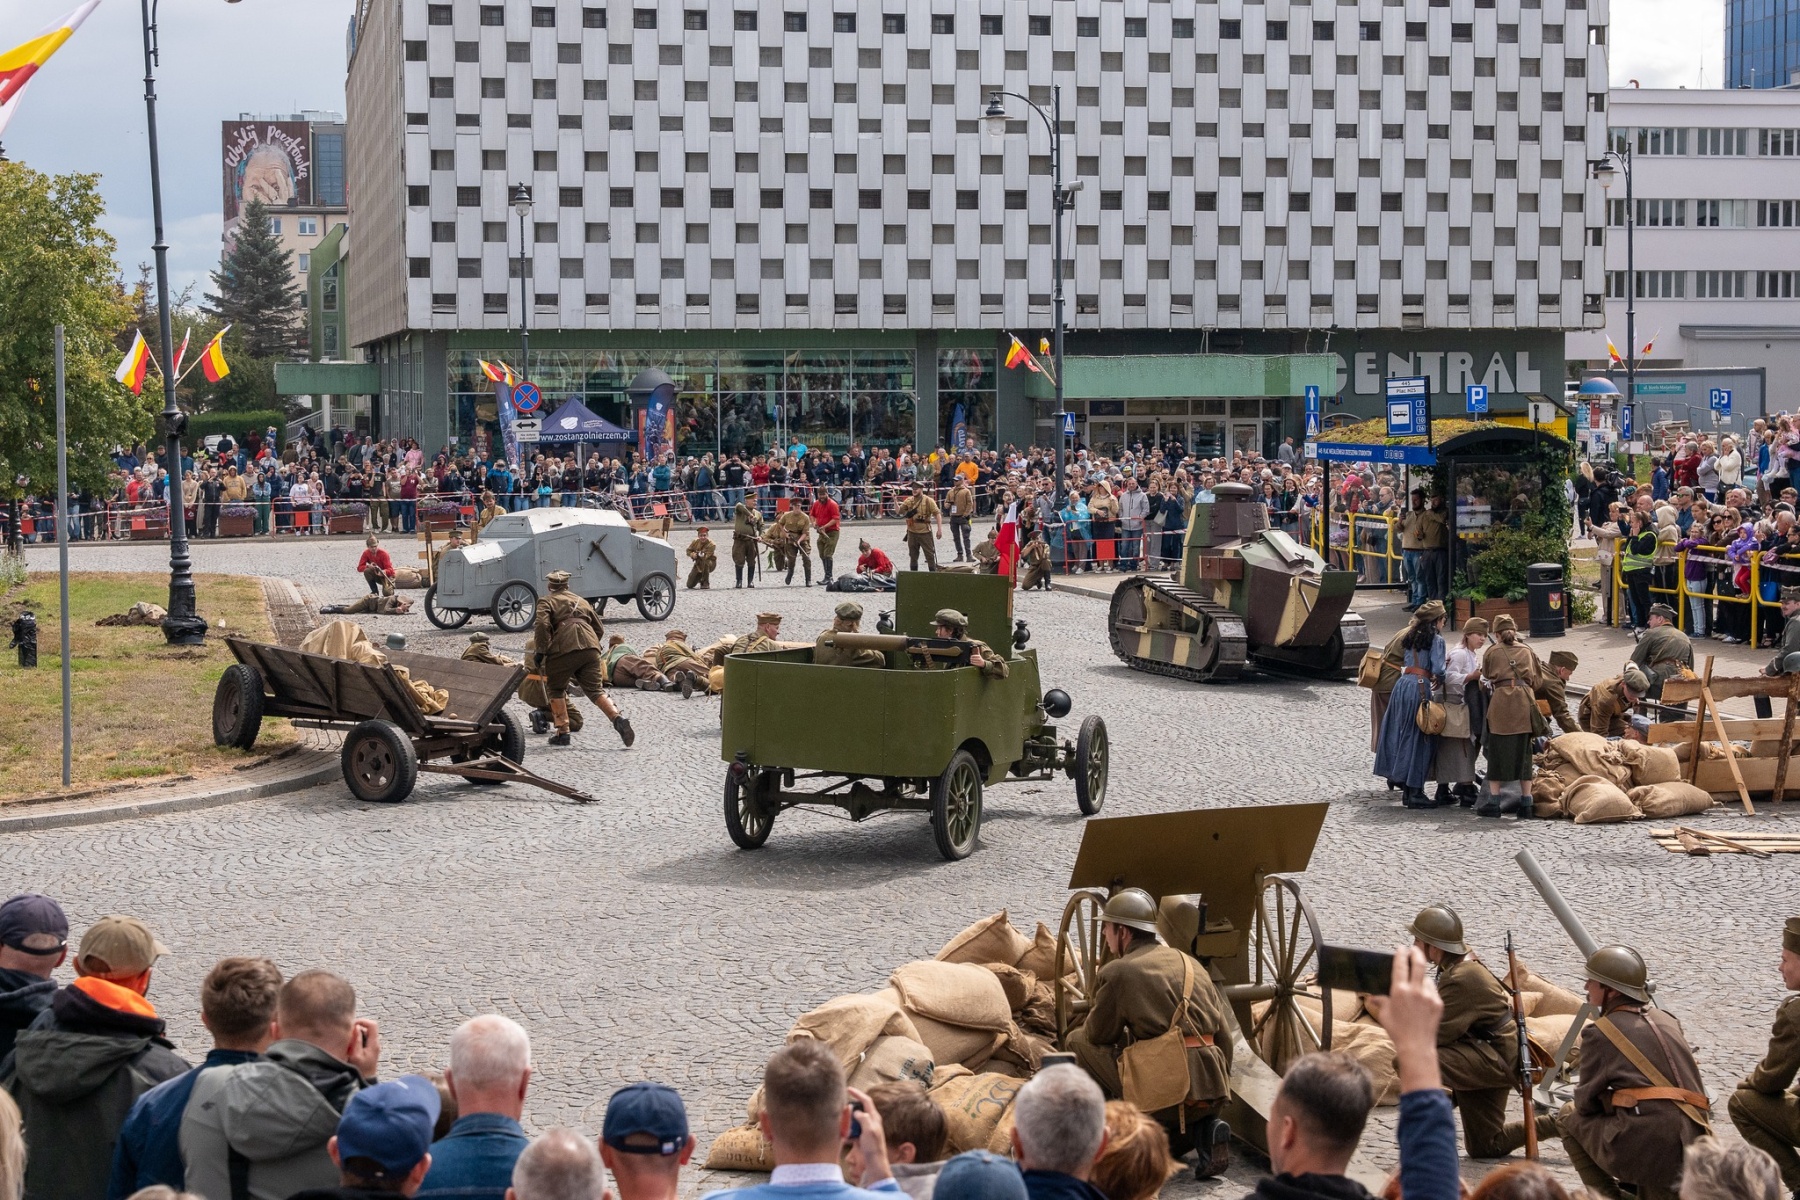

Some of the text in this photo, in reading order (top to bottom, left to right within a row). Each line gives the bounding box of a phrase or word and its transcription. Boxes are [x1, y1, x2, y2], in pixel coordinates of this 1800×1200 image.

[225, 124, 259, 167] Wyślij
[1471, 387, 1484, 405] P
[1712, 390, 1719, 408] P
[1624, 409, 1629, 430] P
[540, 431, 630, 441] ww.zostanzolnierzem.pl
